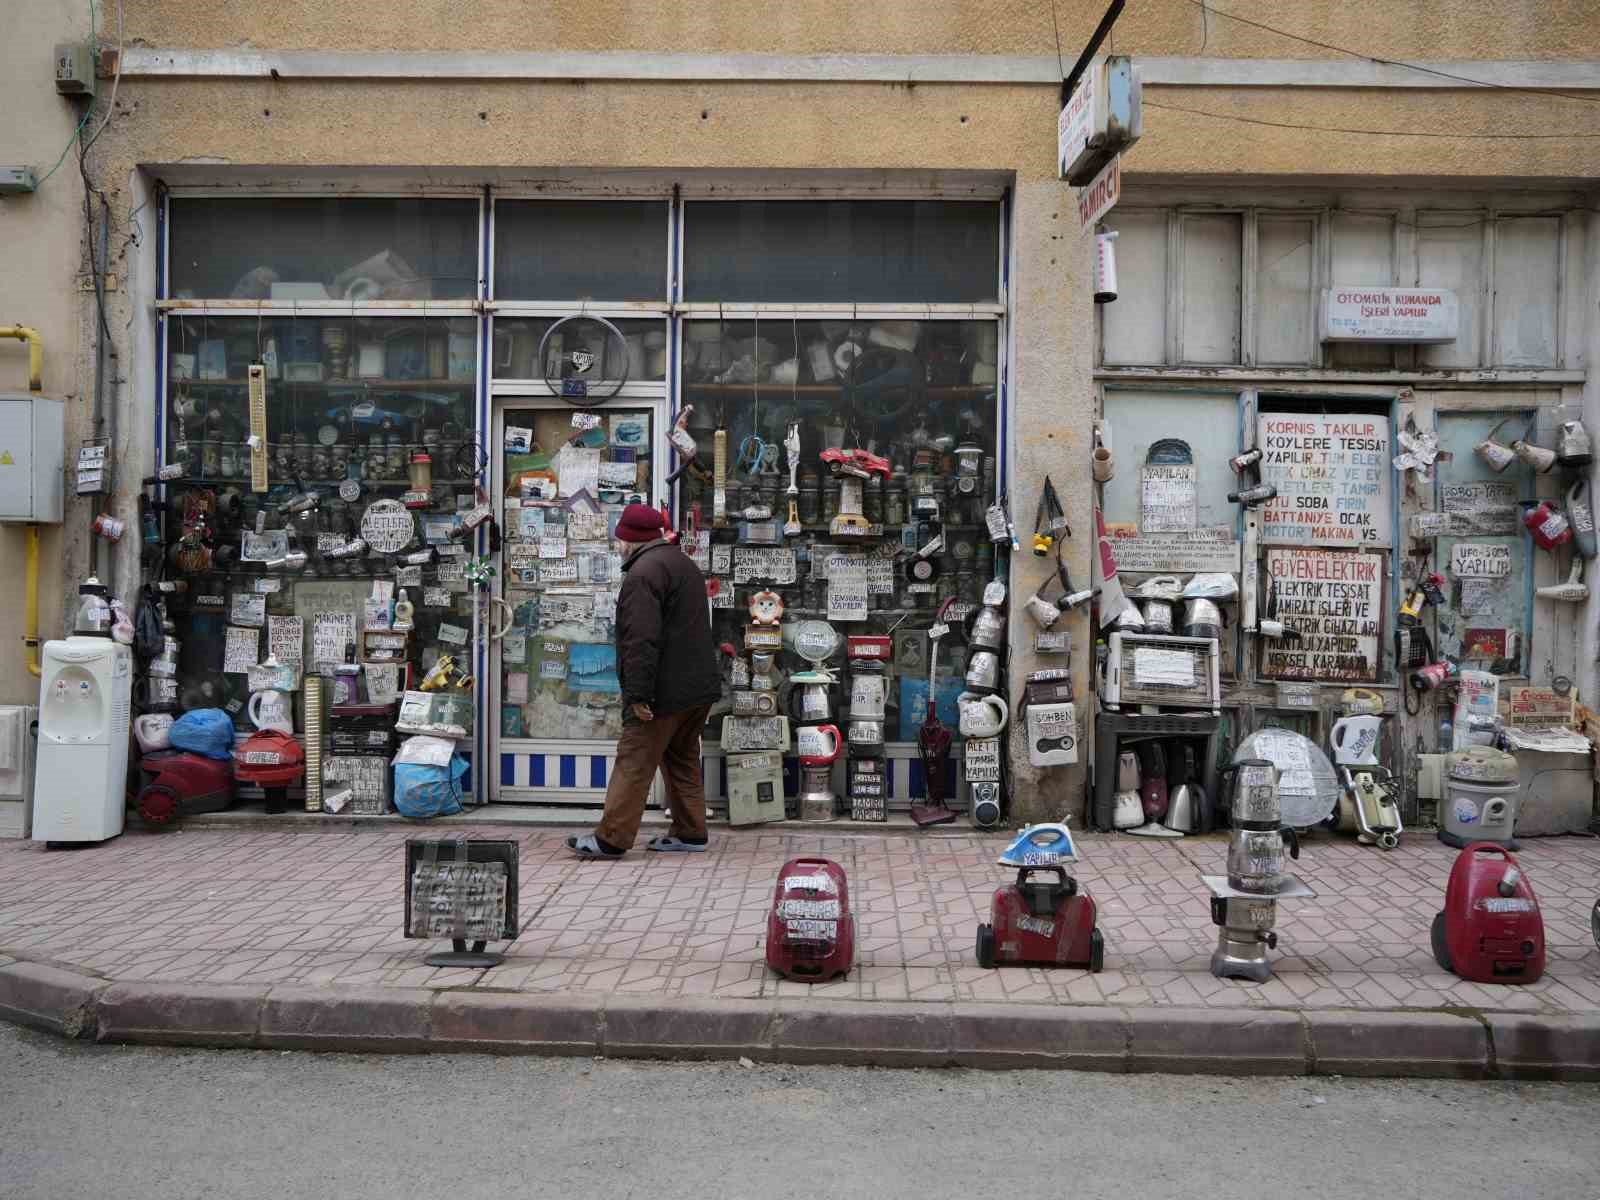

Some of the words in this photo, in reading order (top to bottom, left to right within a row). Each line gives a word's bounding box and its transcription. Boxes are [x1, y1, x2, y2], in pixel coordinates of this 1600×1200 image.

[1296, 496, 1329, 509] SOBA
[1340, 511, 1372, 526] OCAK
[1263, 526, 1305, 539] MOTOR
[1272, 598, 1315, 615] AMİRAT
[1355, 602, 1369, 617] VE
